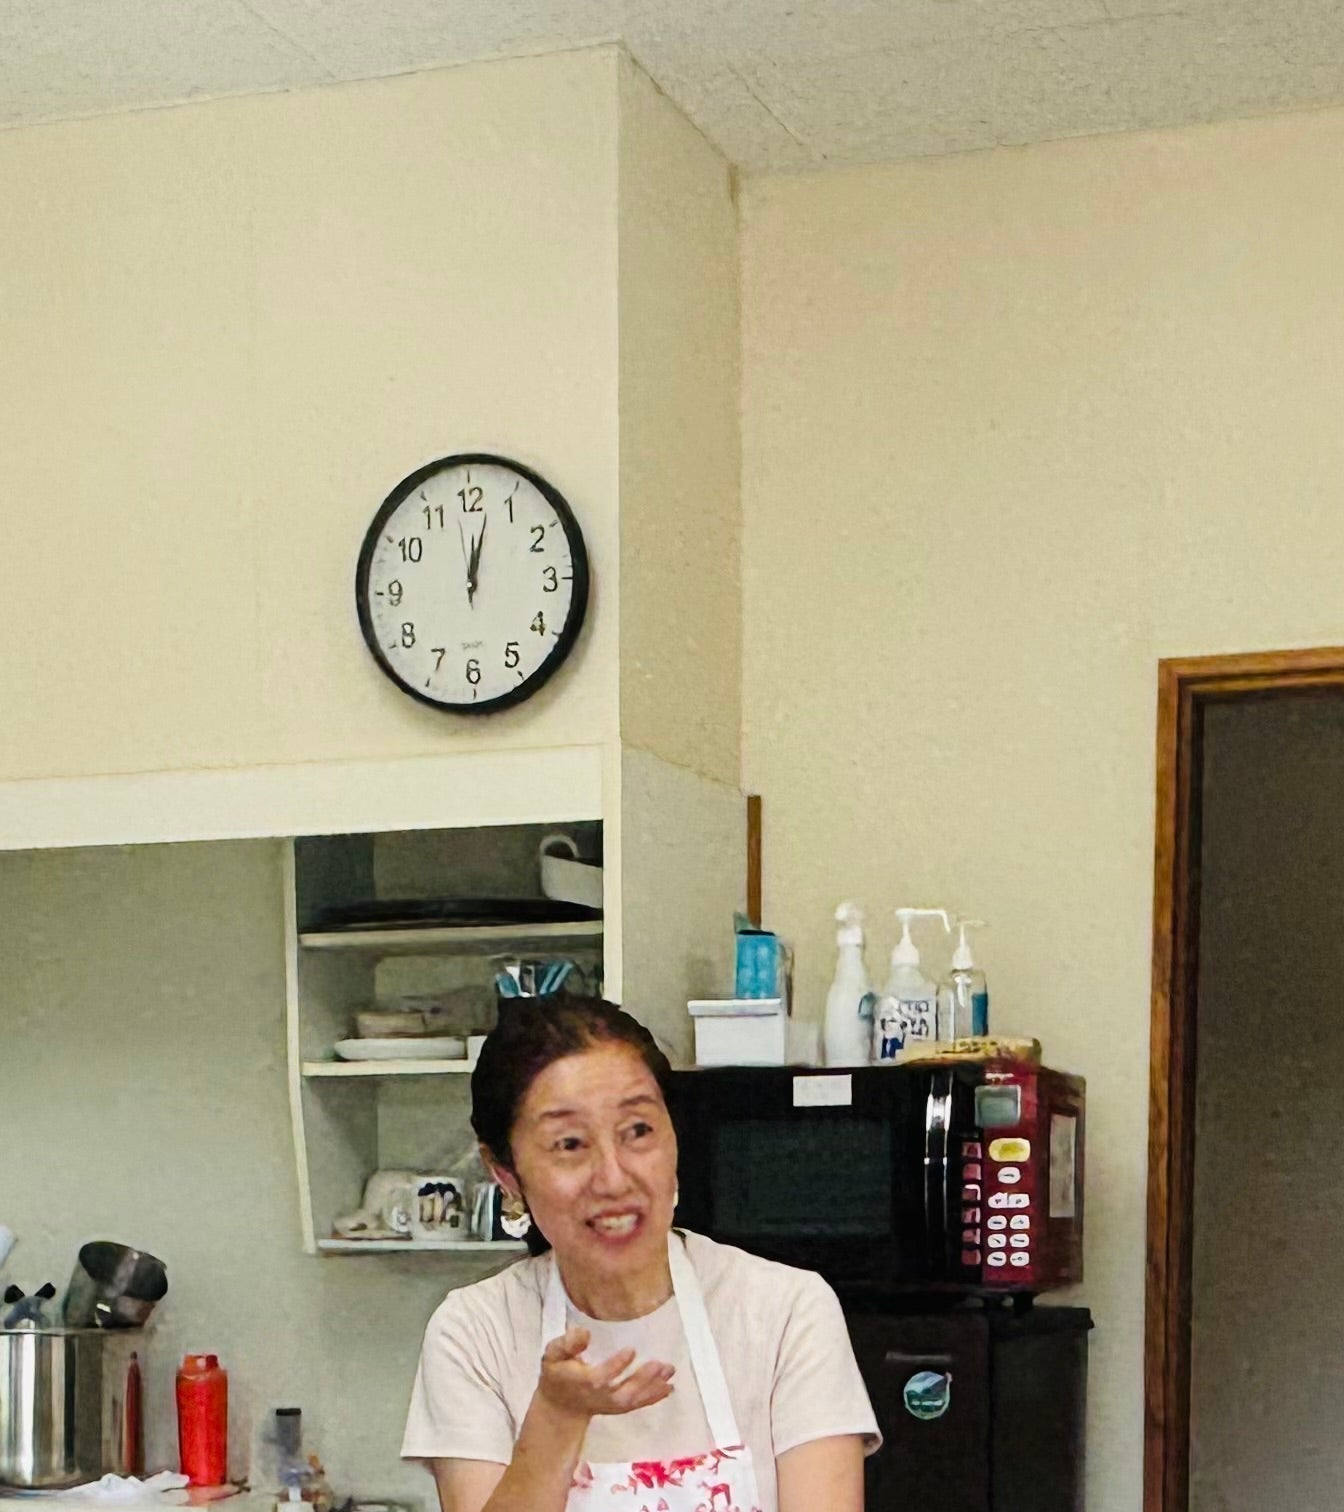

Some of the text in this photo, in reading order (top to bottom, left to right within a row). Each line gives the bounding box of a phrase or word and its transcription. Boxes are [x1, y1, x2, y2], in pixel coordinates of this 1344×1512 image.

[457, 486, 484, 513] 12
[503, 495, 514, 524] 1
[422, 504, 445, 530] 11
[398, 536, 423, 563] 10
[529, 524, 545, 552] 2
[388, 579, 403, 606] 9
[542, 566, 558, 593] 3
[401, 622, 416, 649] 8
[529, 611, 547, 637] 4
[430, 647, 446, 672] 7
[504, 641, 520, 669] 5
[465, 658, 481, 685] 6
